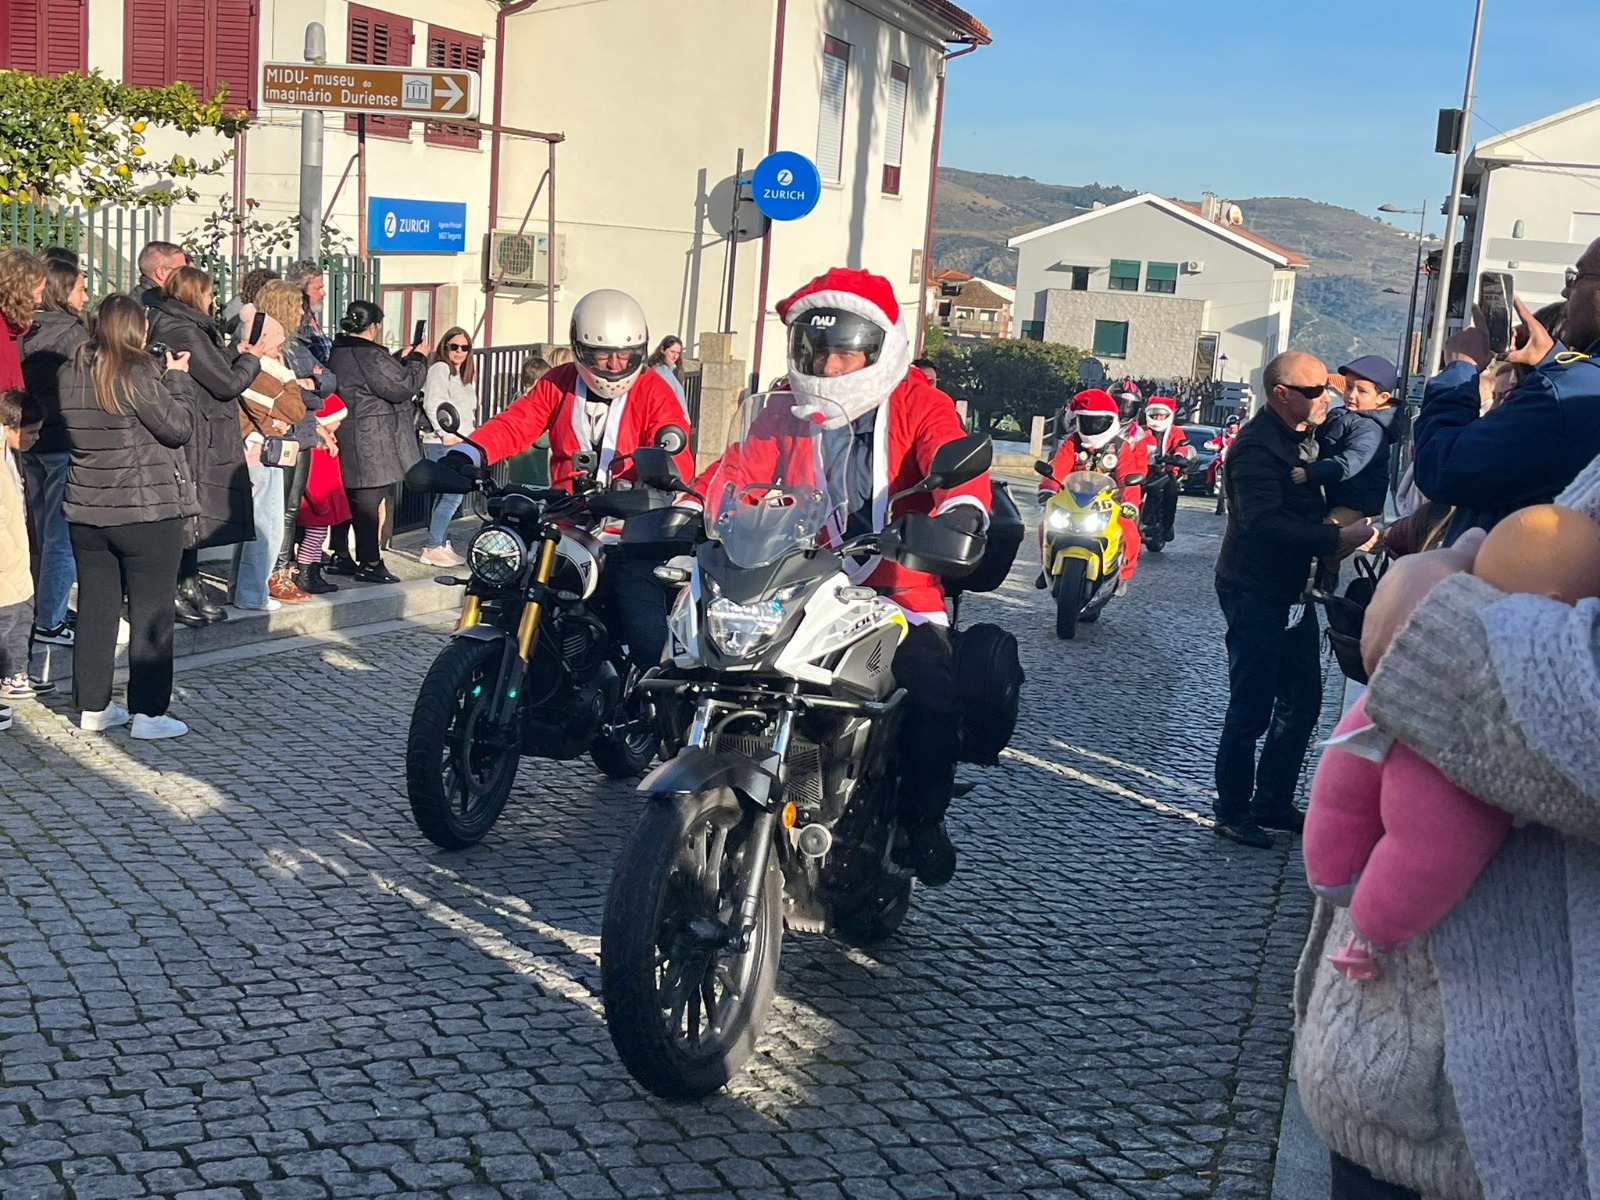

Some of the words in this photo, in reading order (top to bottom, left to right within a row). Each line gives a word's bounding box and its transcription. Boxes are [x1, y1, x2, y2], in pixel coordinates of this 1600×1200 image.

[266, 68, 309, 84] MIDU-
[313, 74, 355, 87] museu
[362, 80, 372, 88] do
[265, 85, 332, 103] imaginário
[341, 89, 398, 106] Duriense
[763, 188, 805, 200] ZURICH
[399, 218, 430, 233] ZURICH
